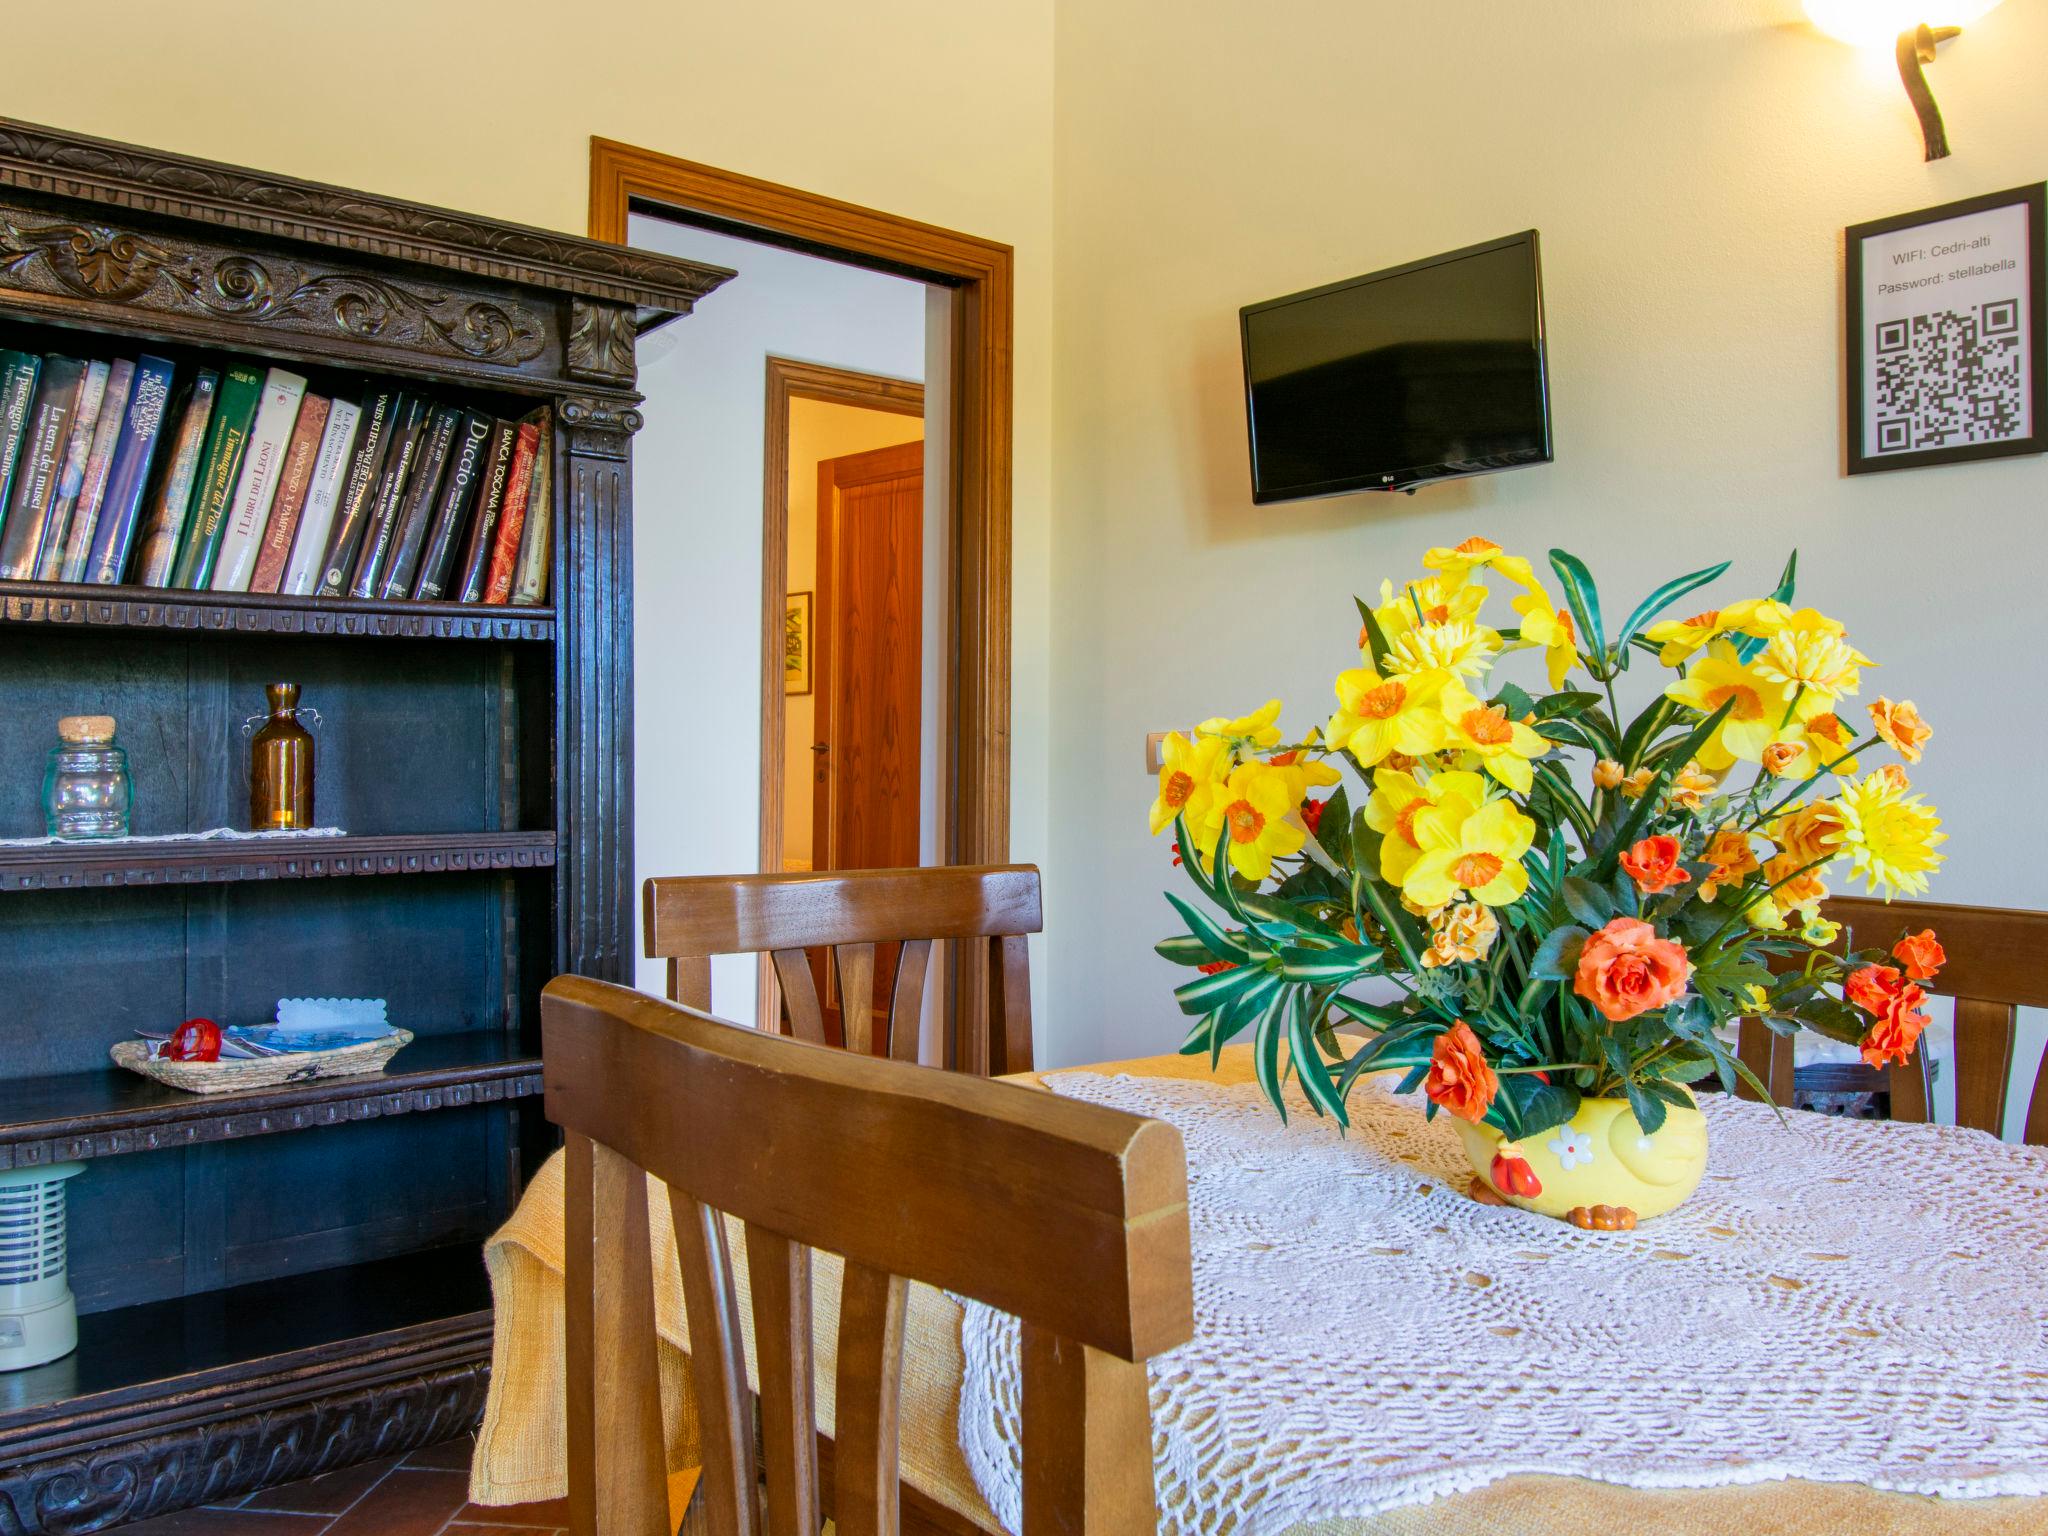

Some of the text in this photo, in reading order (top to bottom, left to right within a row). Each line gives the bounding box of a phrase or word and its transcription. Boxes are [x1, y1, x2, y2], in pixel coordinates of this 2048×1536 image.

[1892, 234, 1991, 266] WIFI: Cedri-alti
[1877, 258, 2016, 295] Password: stellabella
[141, 369, 150, 379] IN
[135, 379, 147, 406] SIENA
[142, 377, 155, 405] DELLA
[1, 365, 35, 477] Il paesaggio toscano
[37, 403, 50, 429] paesaggio
[135, 405, 148, 435] SCALA
[139, 374, 162, 442] DI SANTA MARIA
[148, 385, 166, 436] LO SPEDALE
[334, 408, 343, 422] NEL
[343, 411, 353, 423] LA
[443, 416, 453, 428] Pio
[319, 422, 341, 479] RINASCIMENTO
[334, 422, 350, 458] PITTURA
[350, 393, 387, 516] MONTE DEI PASCHI DI SIENA
[402, 440, 413, 459] GIAN
[434, 449, 444, 461] arti
[438, 441, 446, 449] le
[454, 418, 489, 488] Duccio
[30, 406, 65, 510] La terra dei musei
[31, 456, 39, 466] del
[253, 440, 272, 475] LEONI
[487, 428, 512, 509] BANCA TOSCANA
[204, 427, 241, 537] L'immagine del Palio
[250, 476, 262, 495] DEI
[343, 449, 364, 514] LA SEDE STORICA DEL
[382, 482, 391, 498] ROMA
[386, 472, 394, 482] TRA
[392, 459, 408, 493] LORENZO
[271, 440, 309, 549] INNOCENZO X PAMPHILJ
[384, 494, 398, 523] BERNINI
[239, 496, 256, 527] LIBRI
[377, 502, 385, 518] SIENA
